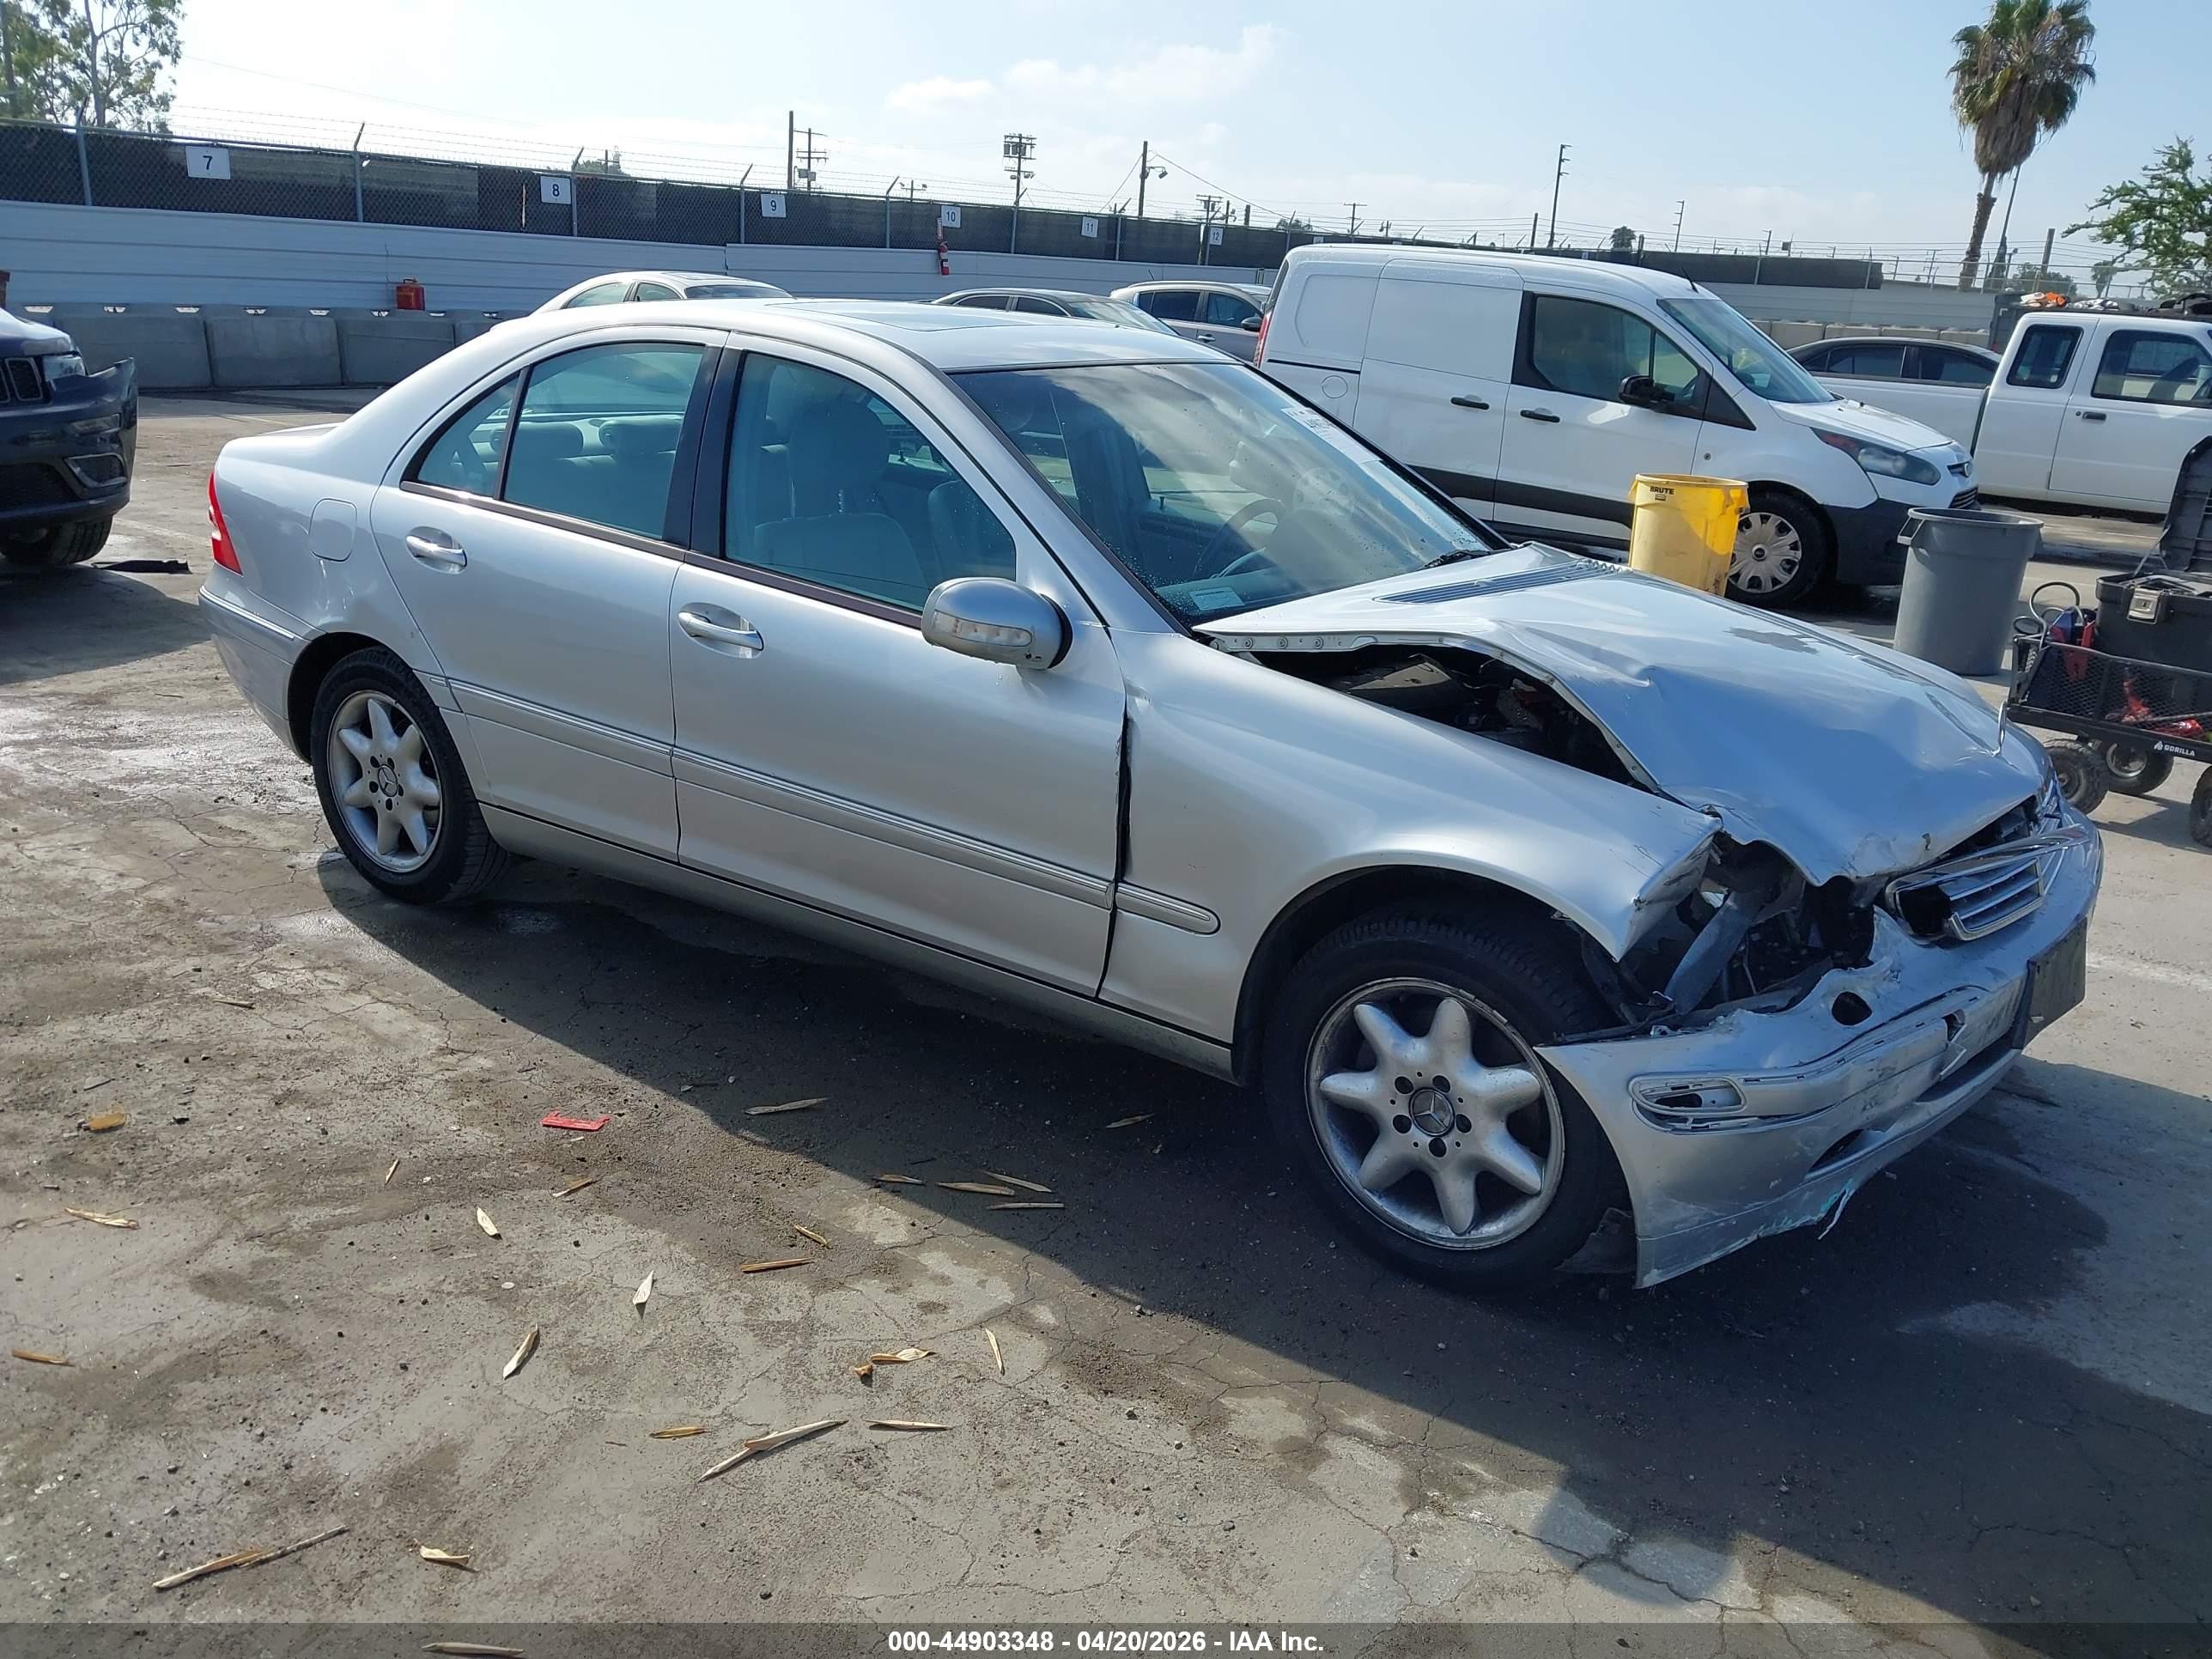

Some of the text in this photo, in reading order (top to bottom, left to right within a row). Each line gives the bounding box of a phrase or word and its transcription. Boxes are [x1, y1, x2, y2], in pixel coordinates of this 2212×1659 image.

[202, 155, 213, 170] 7
[552, 184, 560, 197] 8
[770, 199, 777, 211] 9
[946, 211, 956, 222] 10
[1085, 222, 1094, 233] 11
[1212, 232, 1220, 241] 12
[1650, 485, 1675, 495] BRUTE
[2164, 744, 2196, 757] GORILLA
